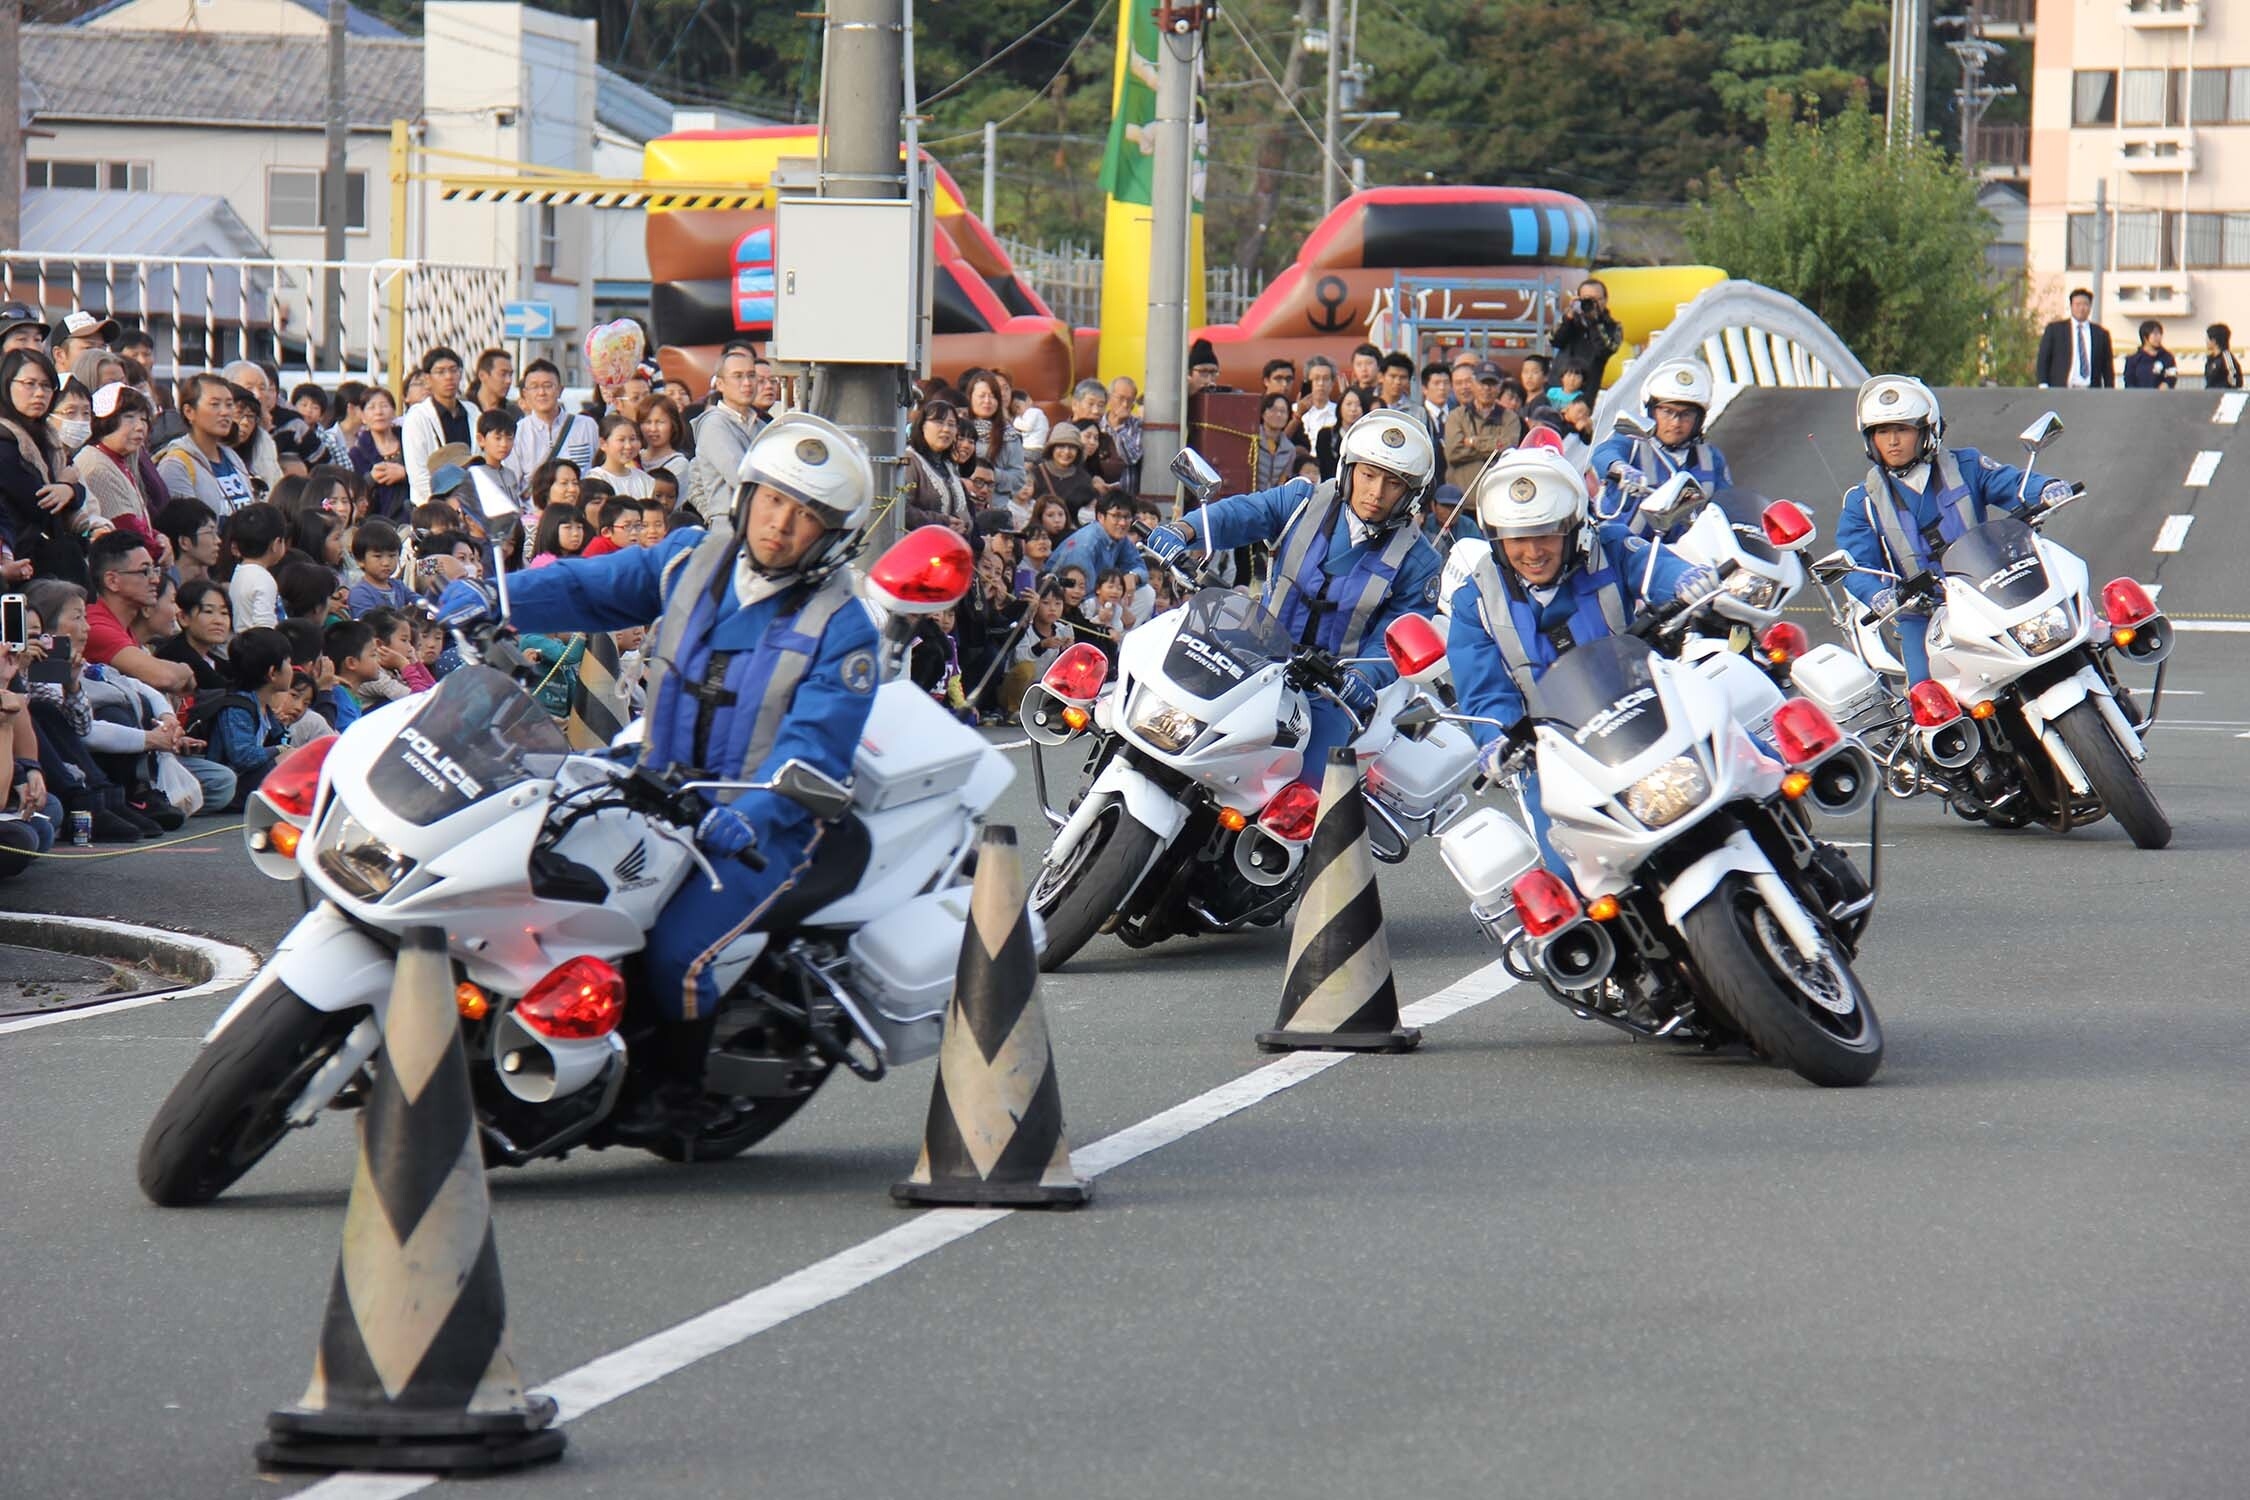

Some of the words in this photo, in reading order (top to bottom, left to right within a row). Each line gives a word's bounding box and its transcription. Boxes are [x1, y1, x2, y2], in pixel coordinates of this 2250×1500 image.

[1979, 556, 2039, 593] POLICE
[1998, 569, 2033, 589] HONDA
[1175, 633, 1245, 680] POLICE
[1184, 650, 1222, 677] HONDA
[1573, 687, 1658, 744] POLICE
[1598, 707, 1646, 738] HONDA
[398, 727, 484, 800] POLICE
[401, 751, 447, 793] HONDA
